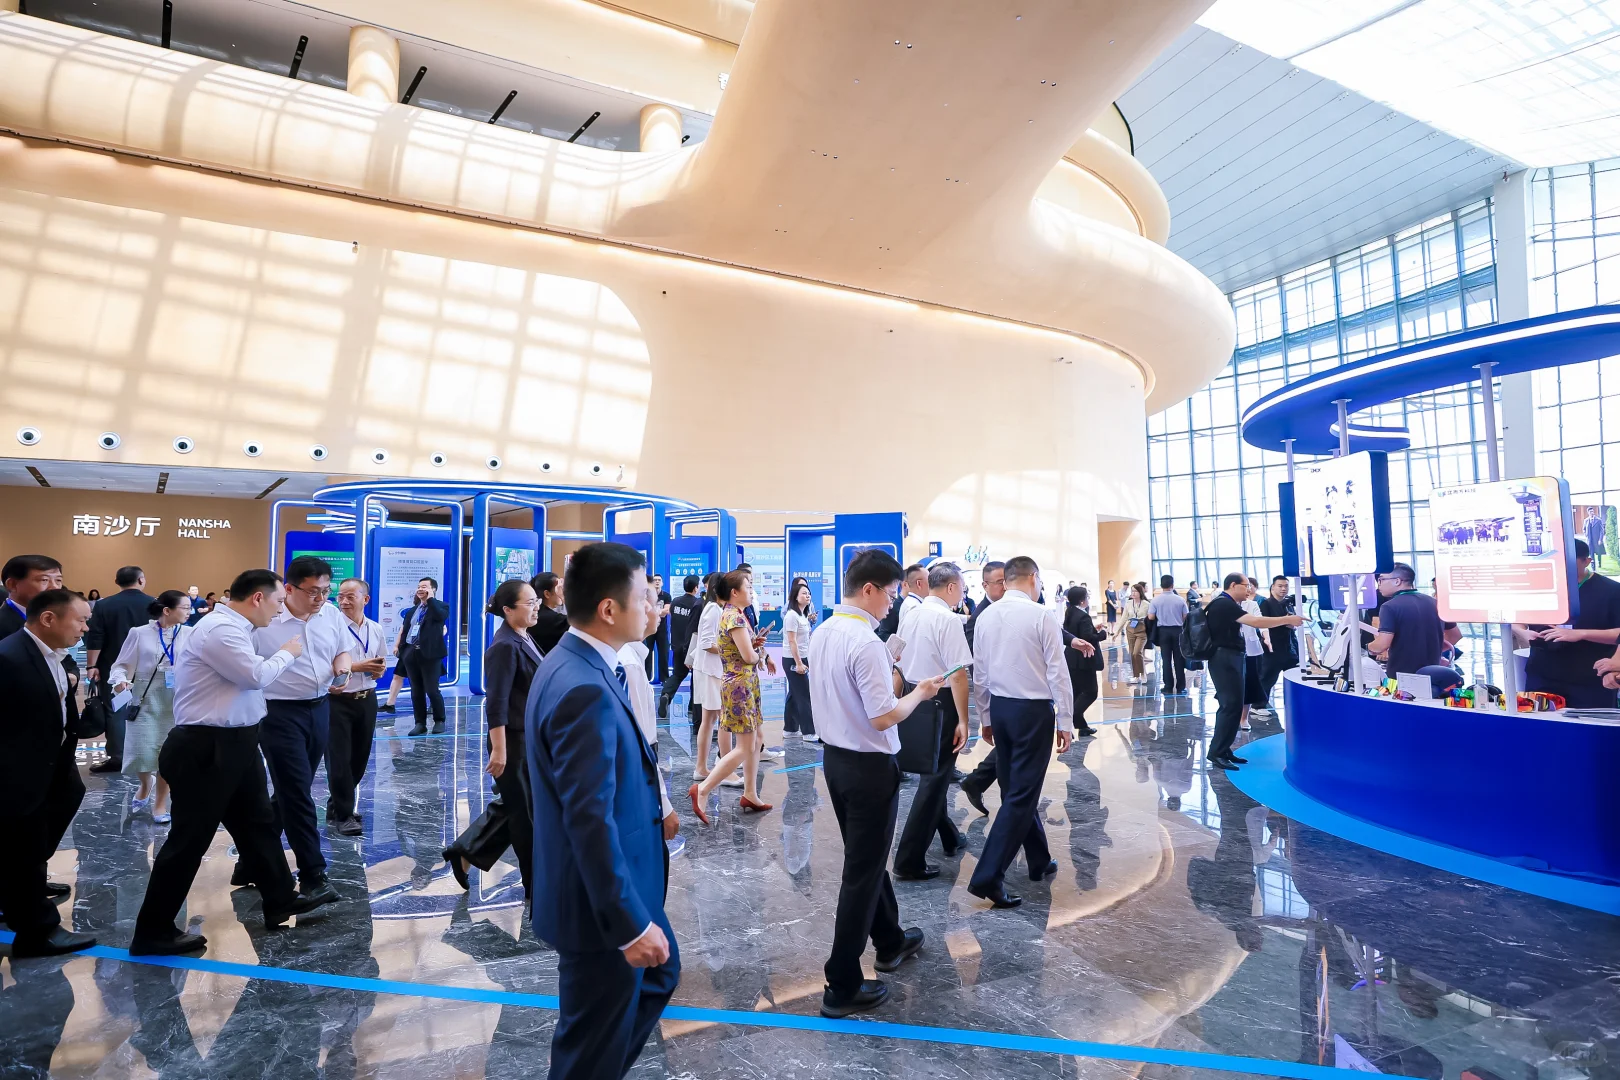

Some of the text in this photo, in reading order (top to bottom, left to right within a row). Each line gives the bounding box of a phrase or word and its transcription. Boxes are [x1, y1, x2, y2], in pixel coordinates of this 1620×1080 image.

[73, 514, 161, 536] 南沙厅
[178, 518, 231, 529] NANSHA
[178, 529, 210, 539] HALL
